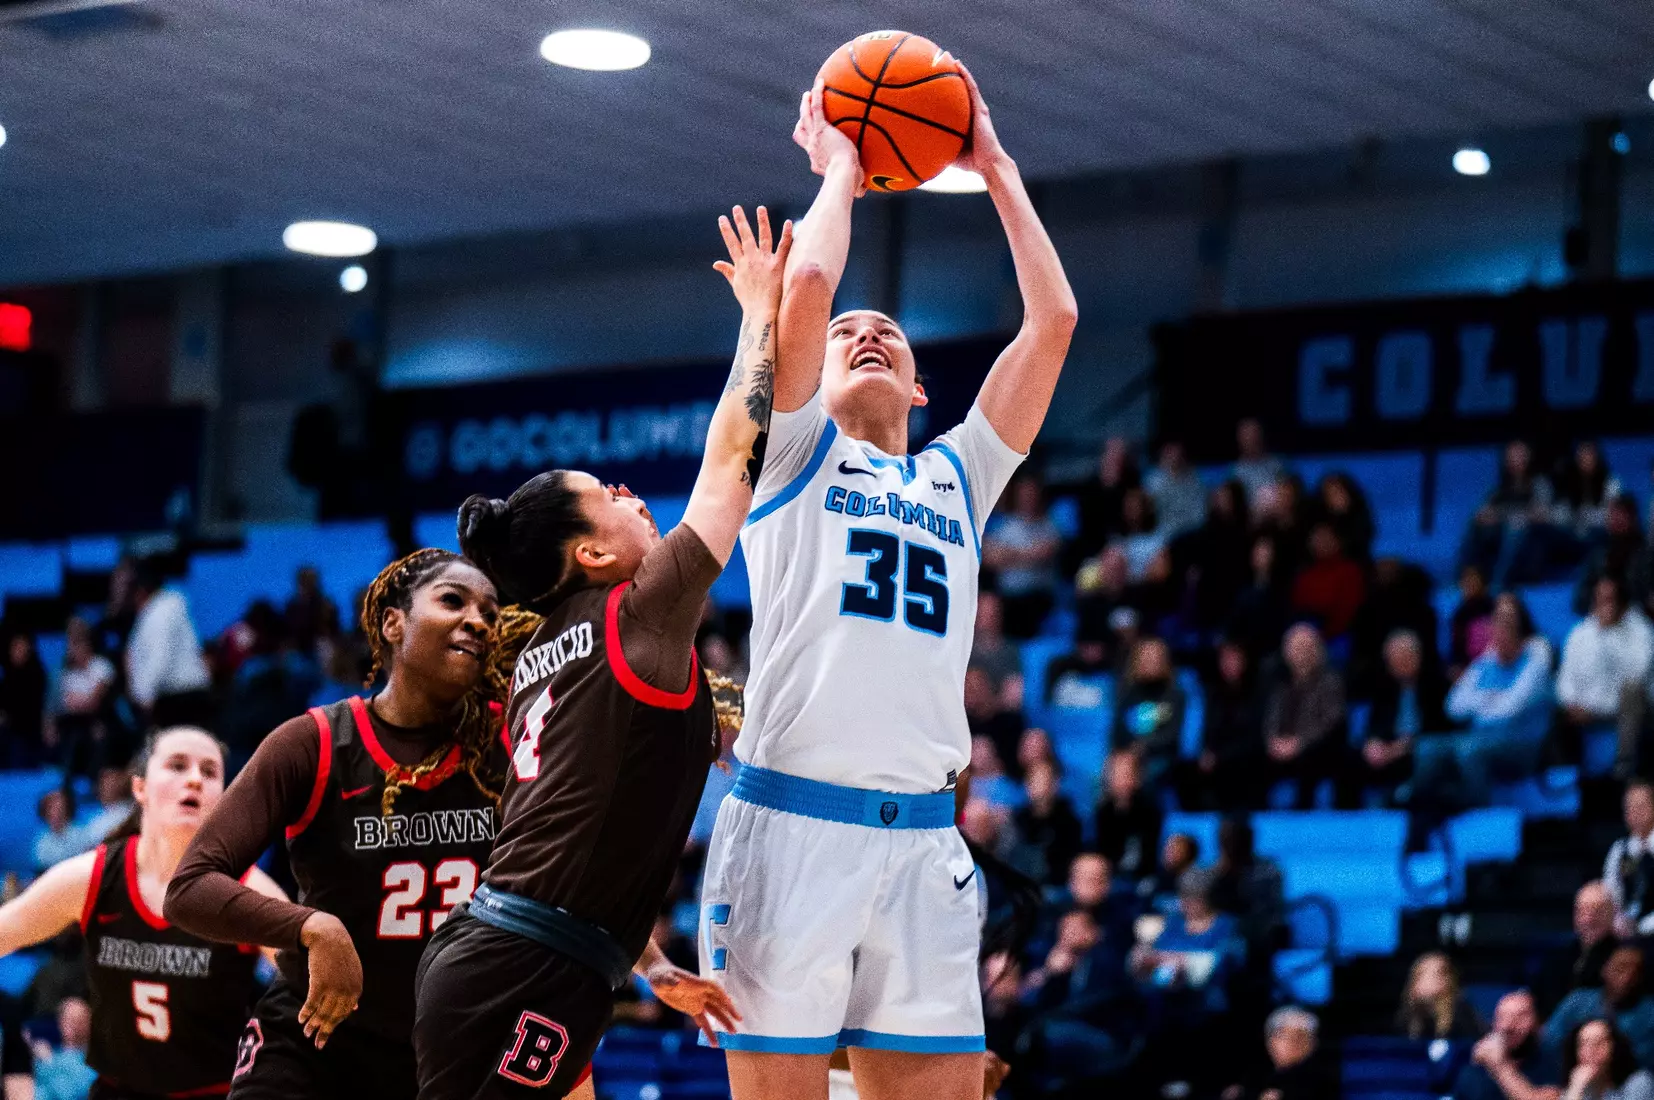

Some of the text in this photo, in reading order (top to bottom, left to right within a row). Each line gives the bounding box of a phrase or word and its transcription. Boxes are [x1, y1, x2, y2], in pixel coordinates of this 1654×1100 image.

[839, 527, 950, 638] 35
[514, 621, 594, 692] AURICIO
[513, 684, 554, 782] 4
[354, 807, 496, 849] BROWN
[376, 857, 480, 939] 23
[97, 934, 212, 978] BROWN
[131, 979, 171, 1042] 5
[498, 1009, 570, 1088] B
